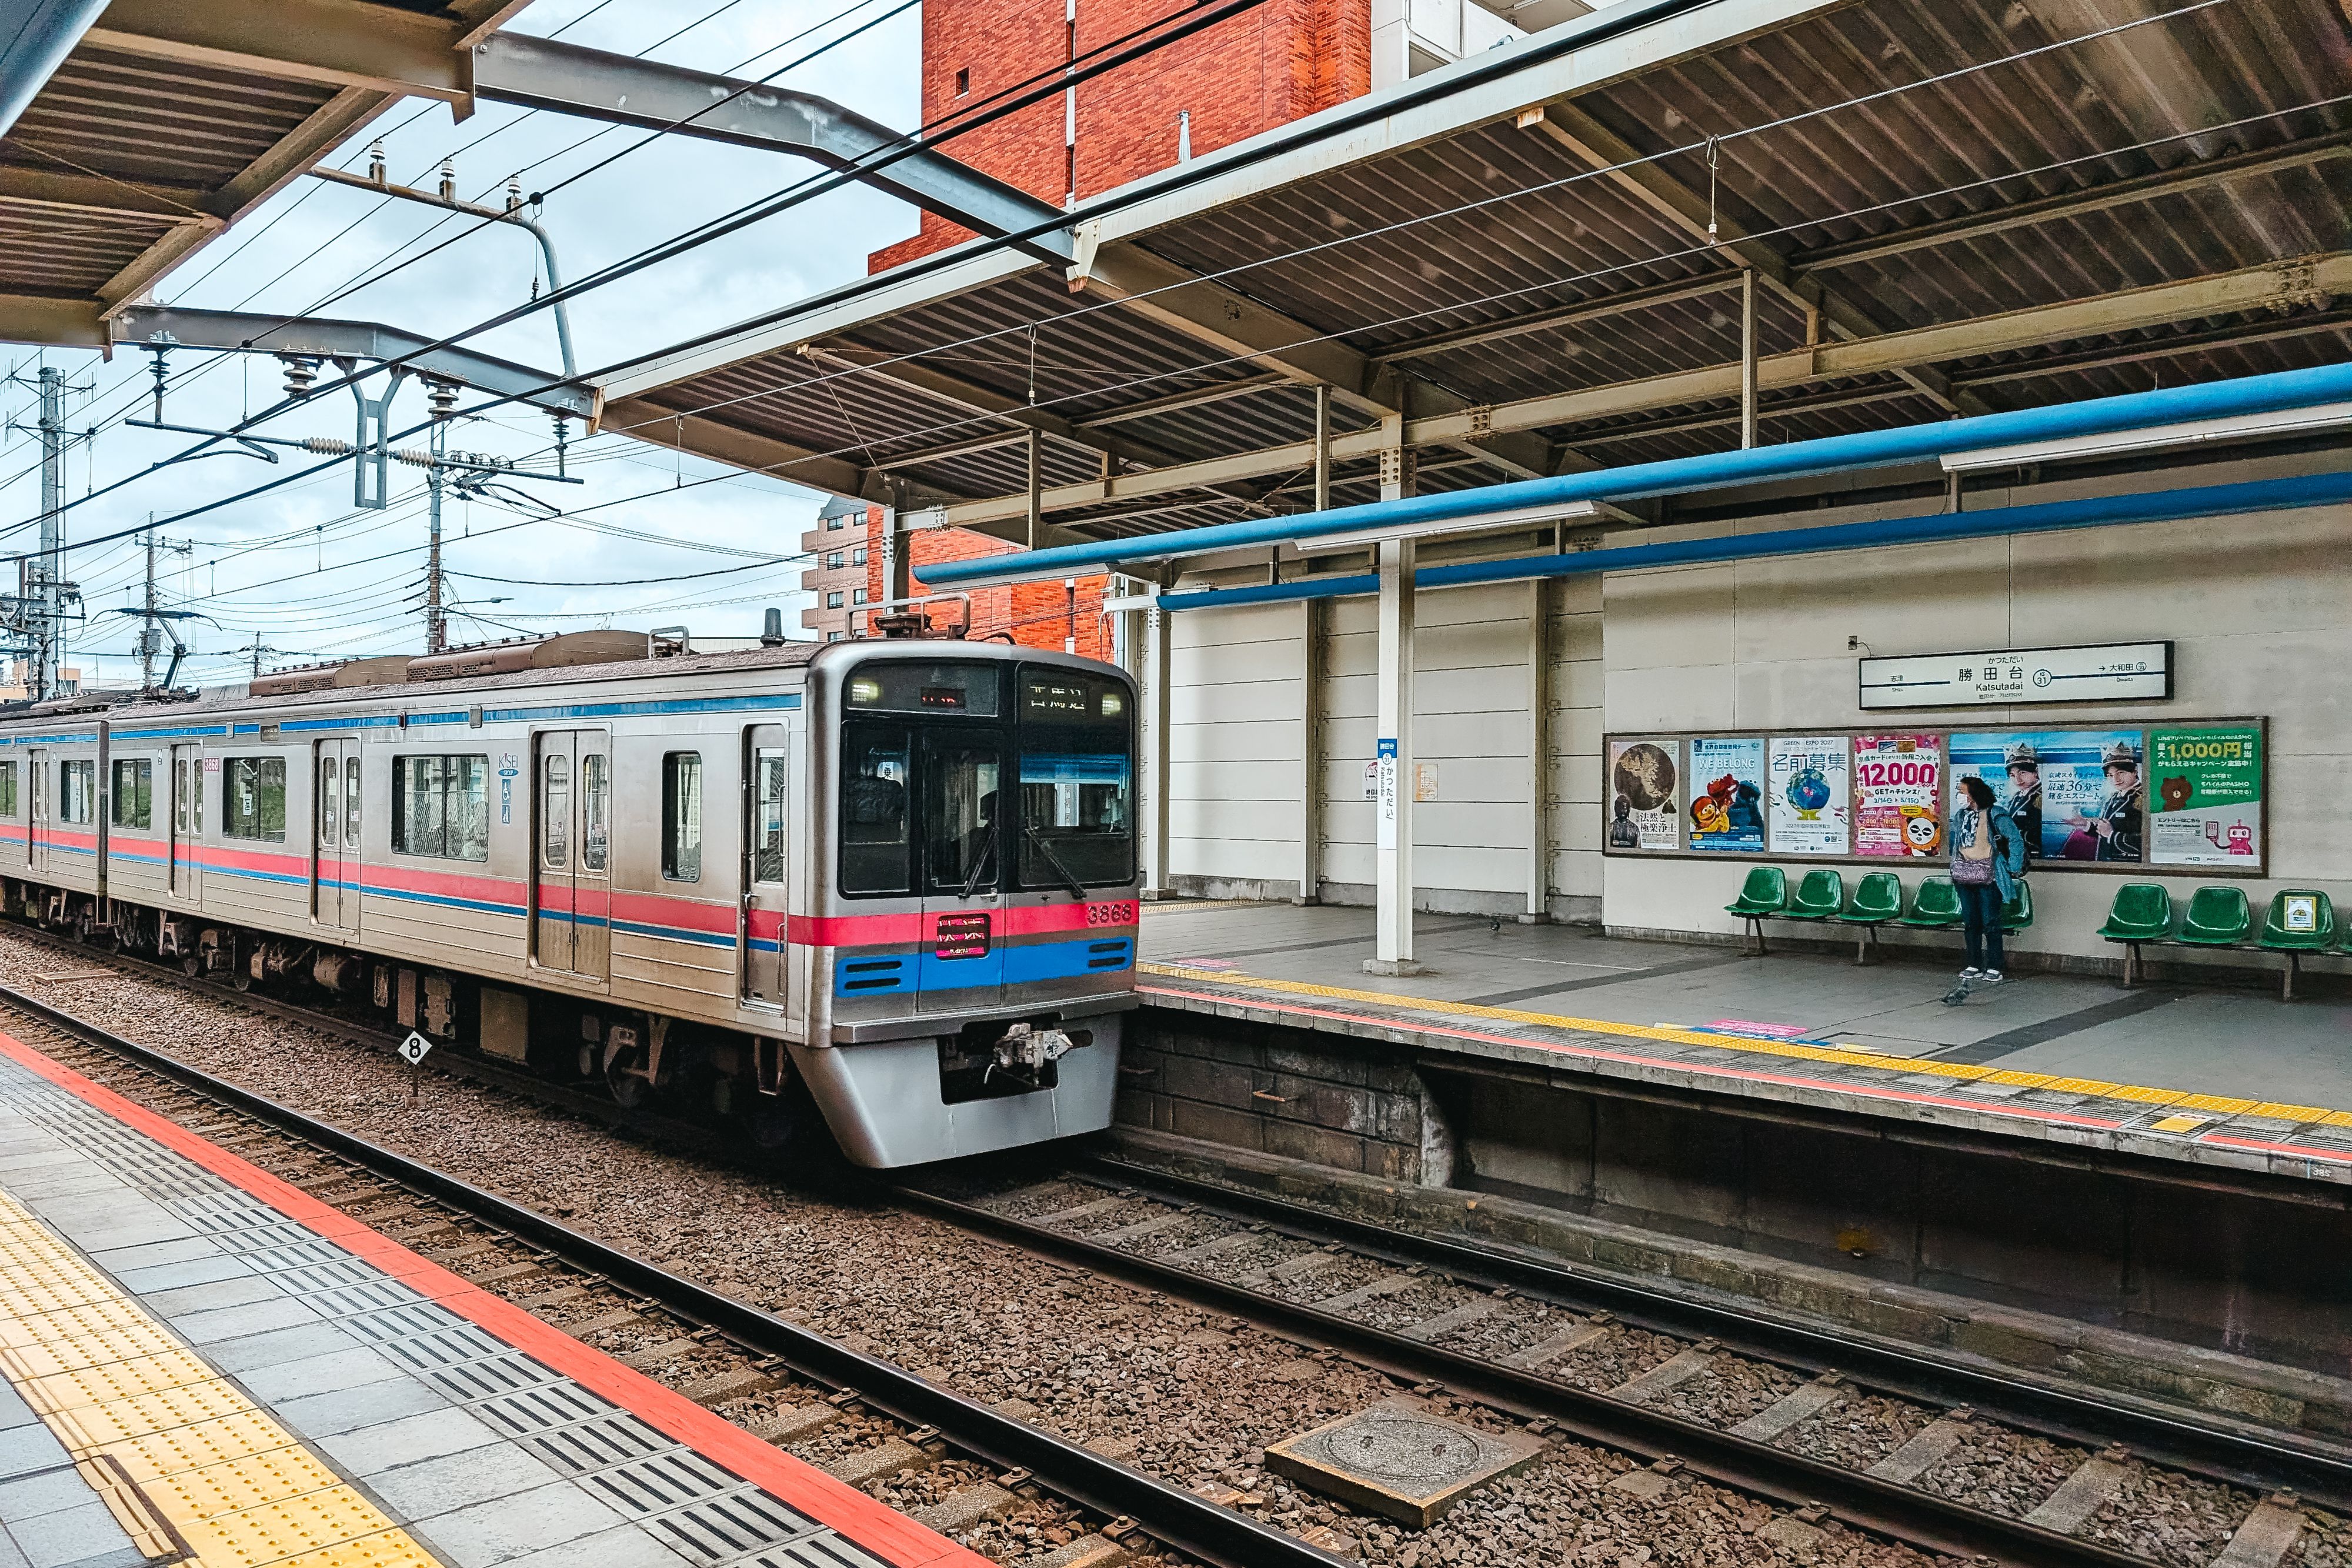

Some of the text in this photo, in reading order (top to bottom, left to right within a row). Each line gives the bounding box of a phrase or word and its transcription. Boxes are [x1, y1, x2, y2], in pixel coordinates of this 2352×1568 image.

[1988, 656, 2023, 664] かつただい
[2109, 663, 2133, 672] 大和田
[1959, 666, 2023, 682] 勝田台
[1976, 682, 2023, 692] Katsutadai
[2167, 742, 2241, 761] 1,000円
[205, 758, 218, 770] 3868
[1699, 758, 1755, 769] WE BELONG
[1773, 753, 1846, 772] 名前募集
[1859, 762, 1935, 787] 12,000
[2048, 780, 2101, 792] 最速36分で
[1640, 812, 1666, 822] 法然と
[1640, 823, 1677, 833] 極楽浄土
[1087, 903, 1132, 925] 3868
[409, 1037, 421, 1059] 8
[2312, 1167, 2332, 1177] 385
